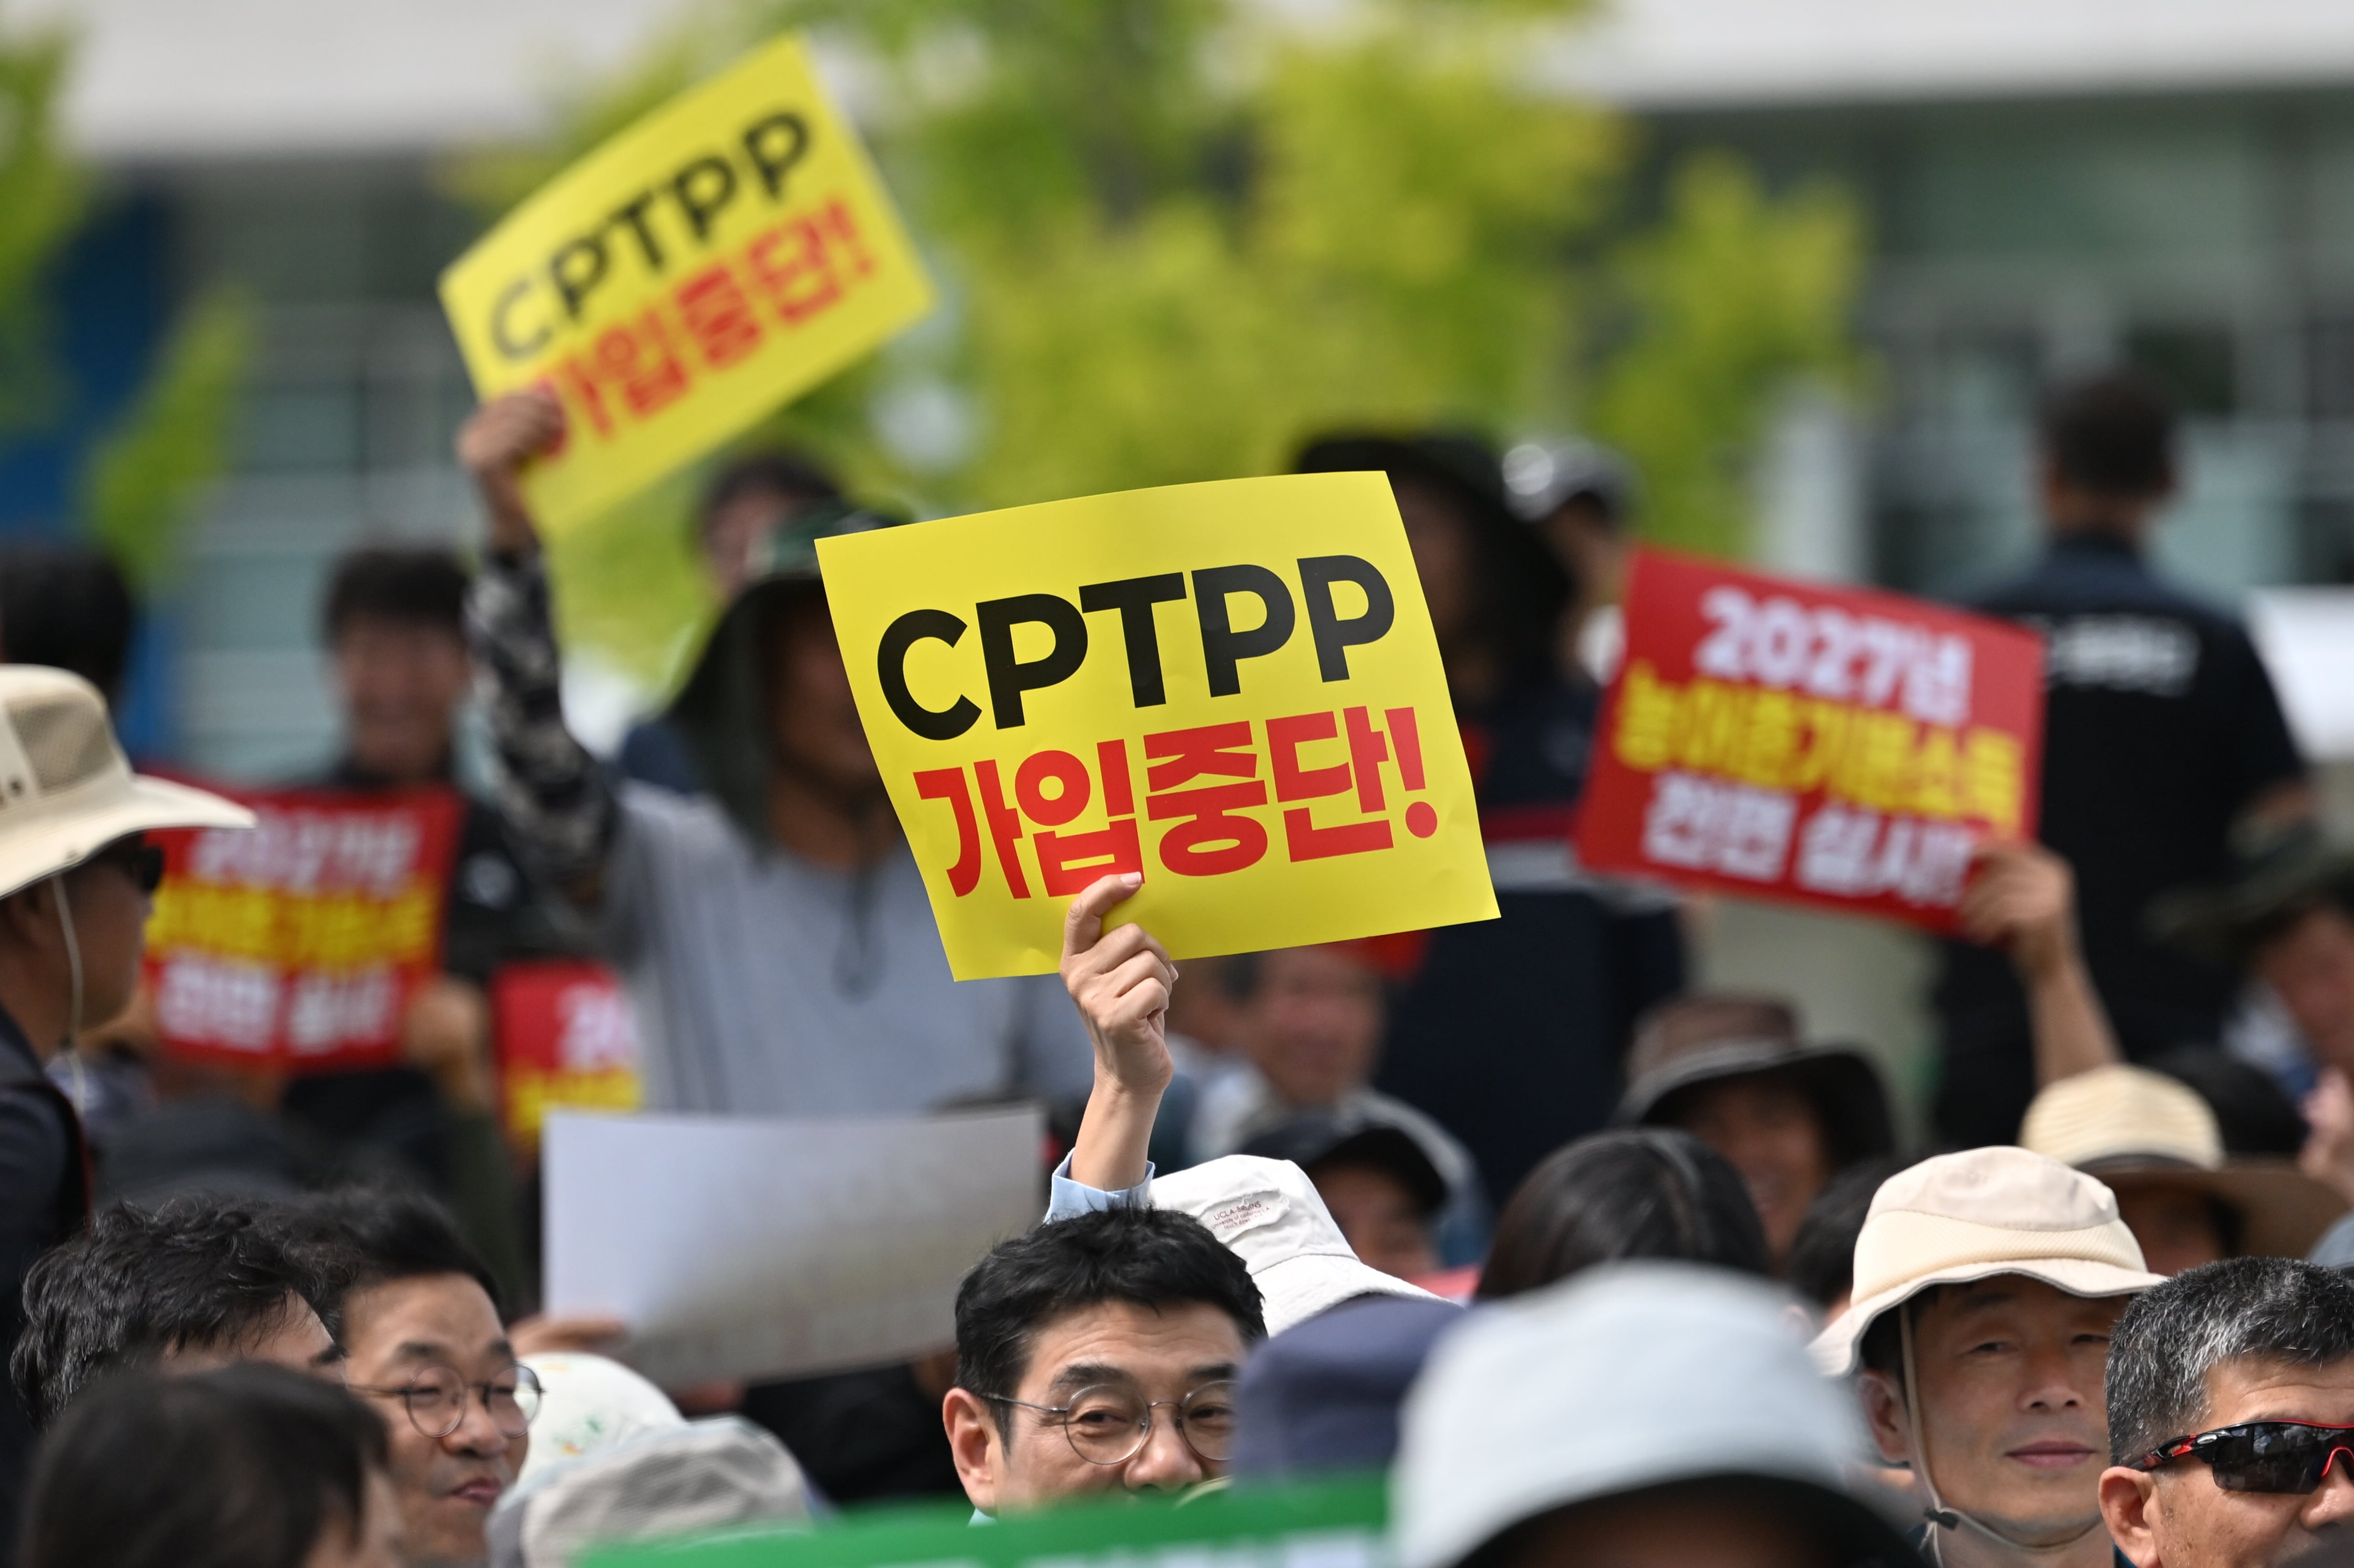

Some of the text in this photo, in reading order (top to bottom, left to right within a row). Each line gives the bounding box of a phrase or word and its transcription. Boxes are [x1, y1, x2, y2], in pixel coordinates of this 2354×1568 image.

[489, 110, 812, 364] CPTPP
[876, 555, 1395, 741] CPTPP
[1697, 589, 1970, 724] 2027년
[913, 705, 1438, 900] 가입중단!
